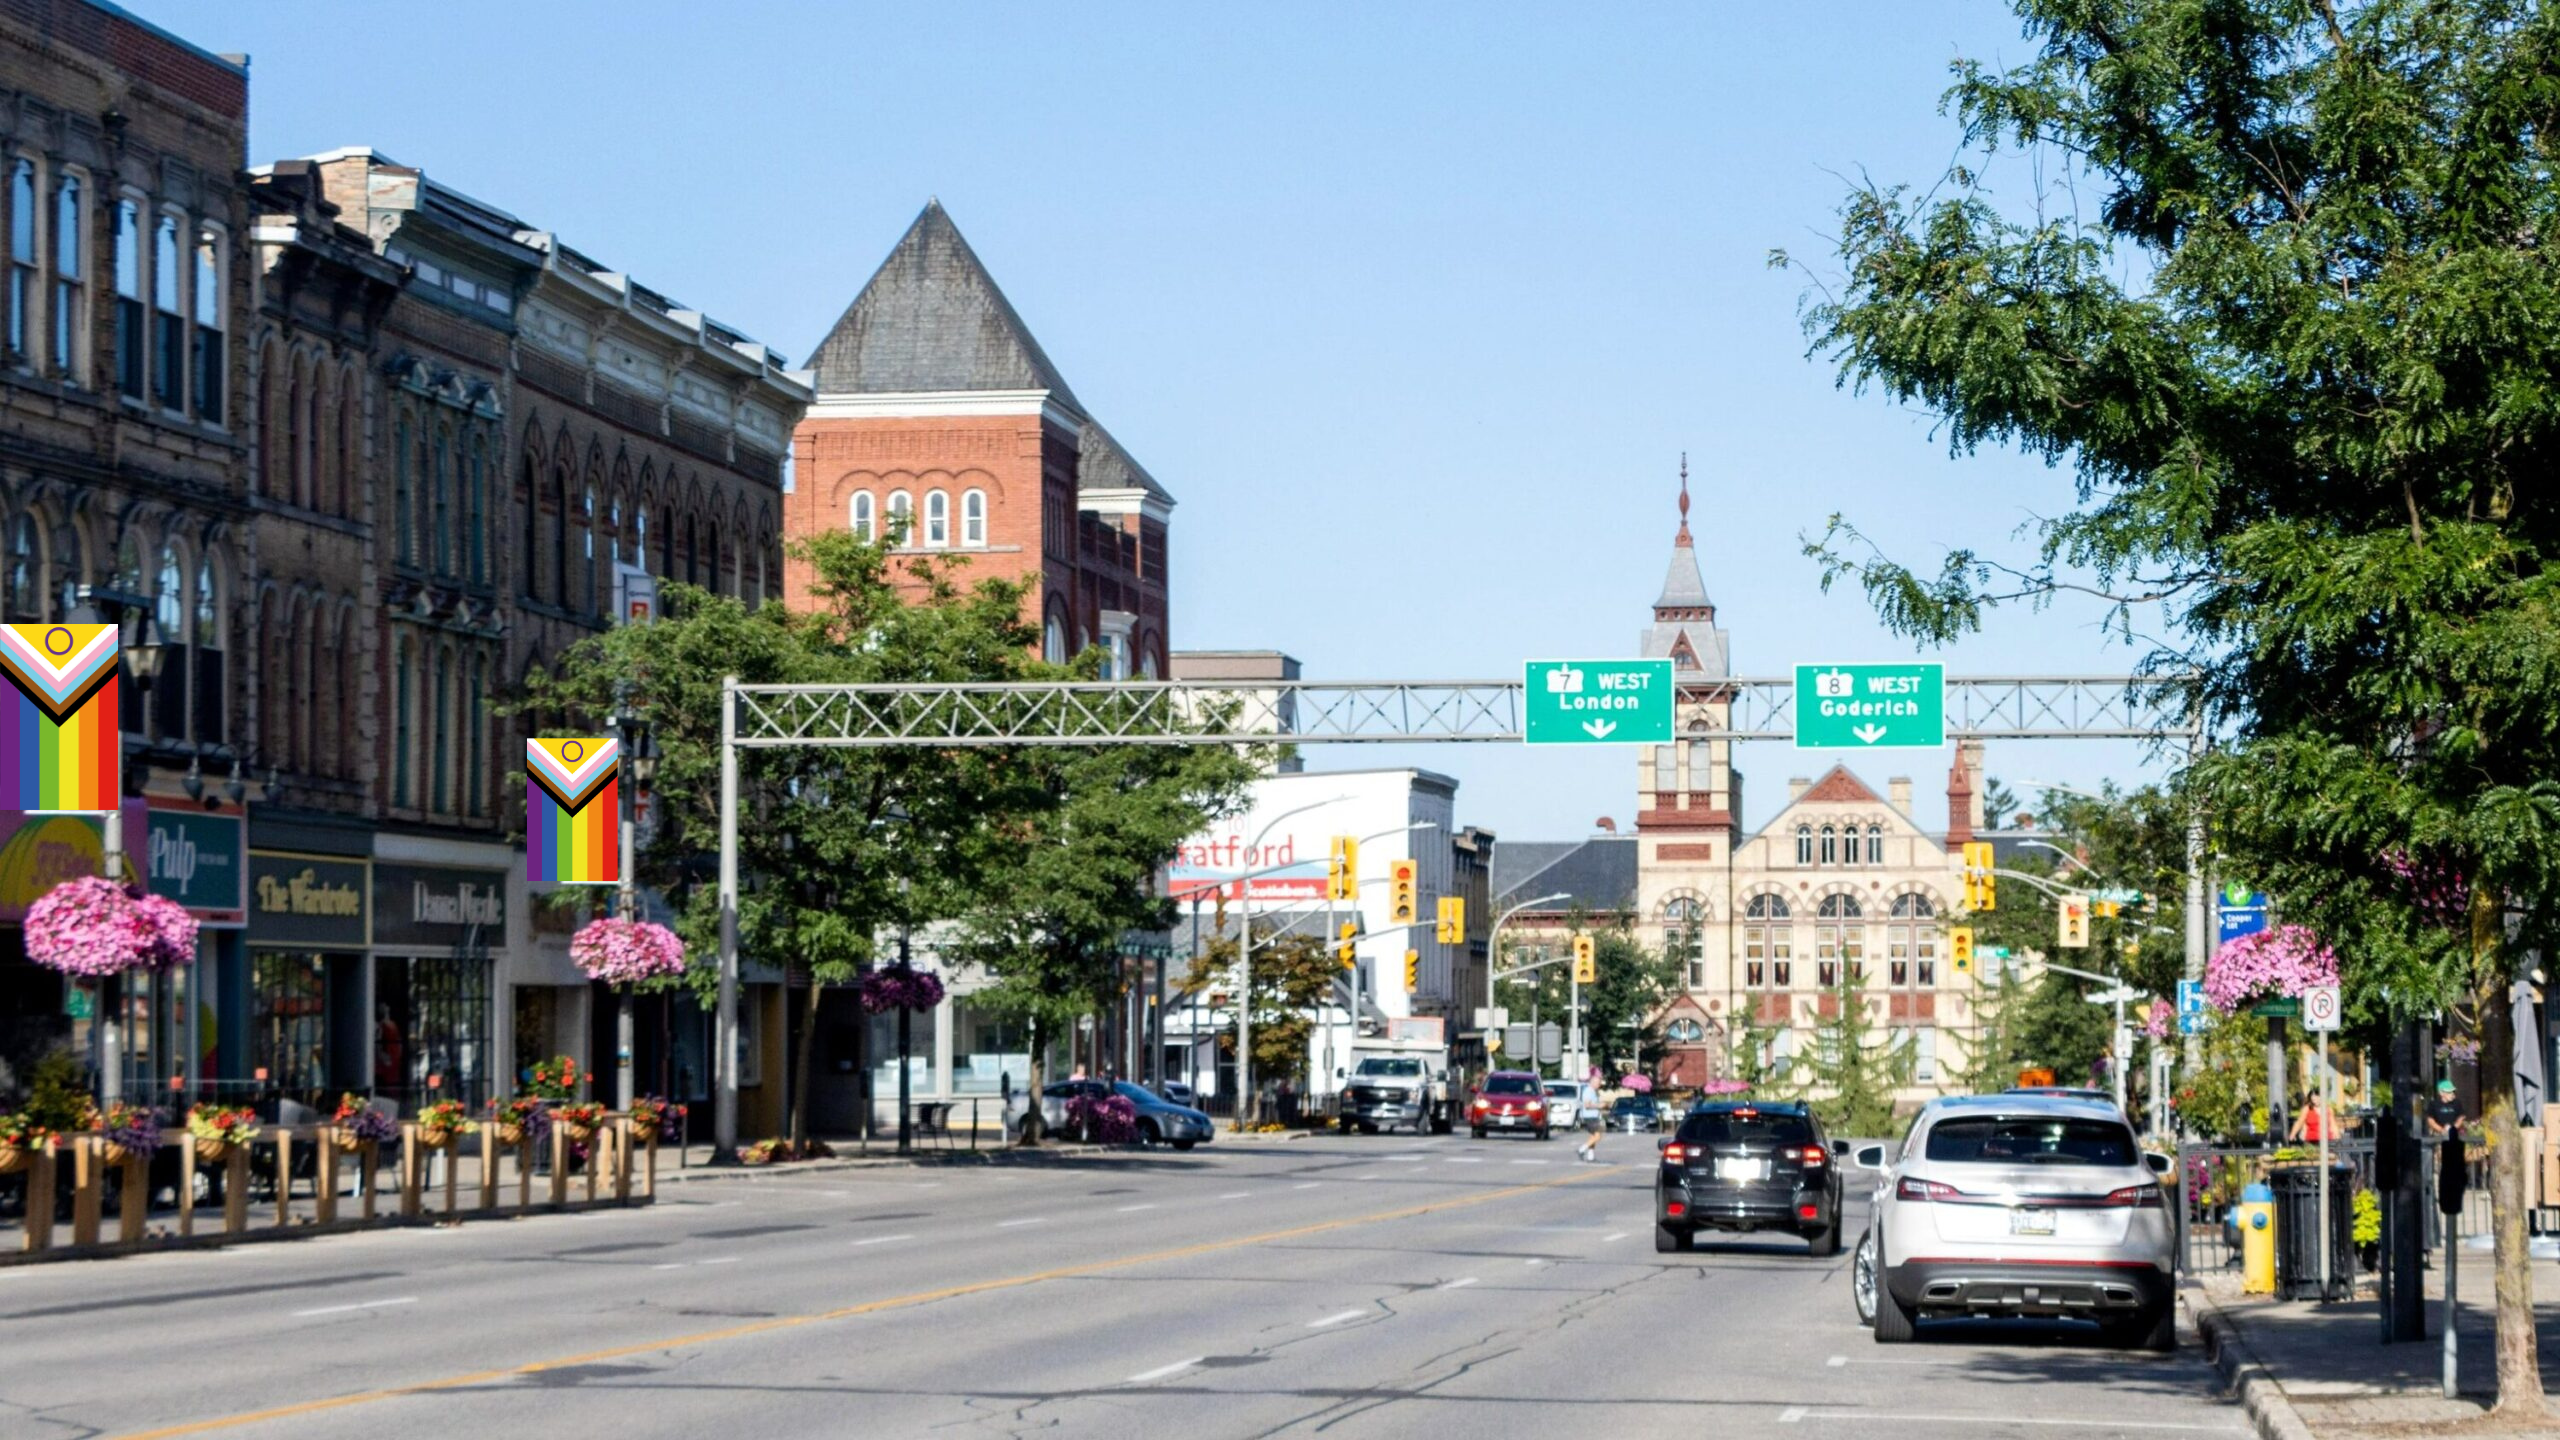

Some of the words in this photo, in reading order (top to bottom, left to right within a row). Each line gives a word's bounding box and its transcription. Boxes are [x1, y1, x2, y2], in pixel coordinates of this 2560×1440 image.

[1559, 673, 1571, 691] 7
[1597, 672, 1652, 691] WEST
[1829, 677, 1841, 695] 8
[1867, 676, 1922, 694] WEST
[1559, 693, 1639, 711] London
[1820, 699, 1919, 717] Goderich
[149, 824, 196, 895] Pulp
